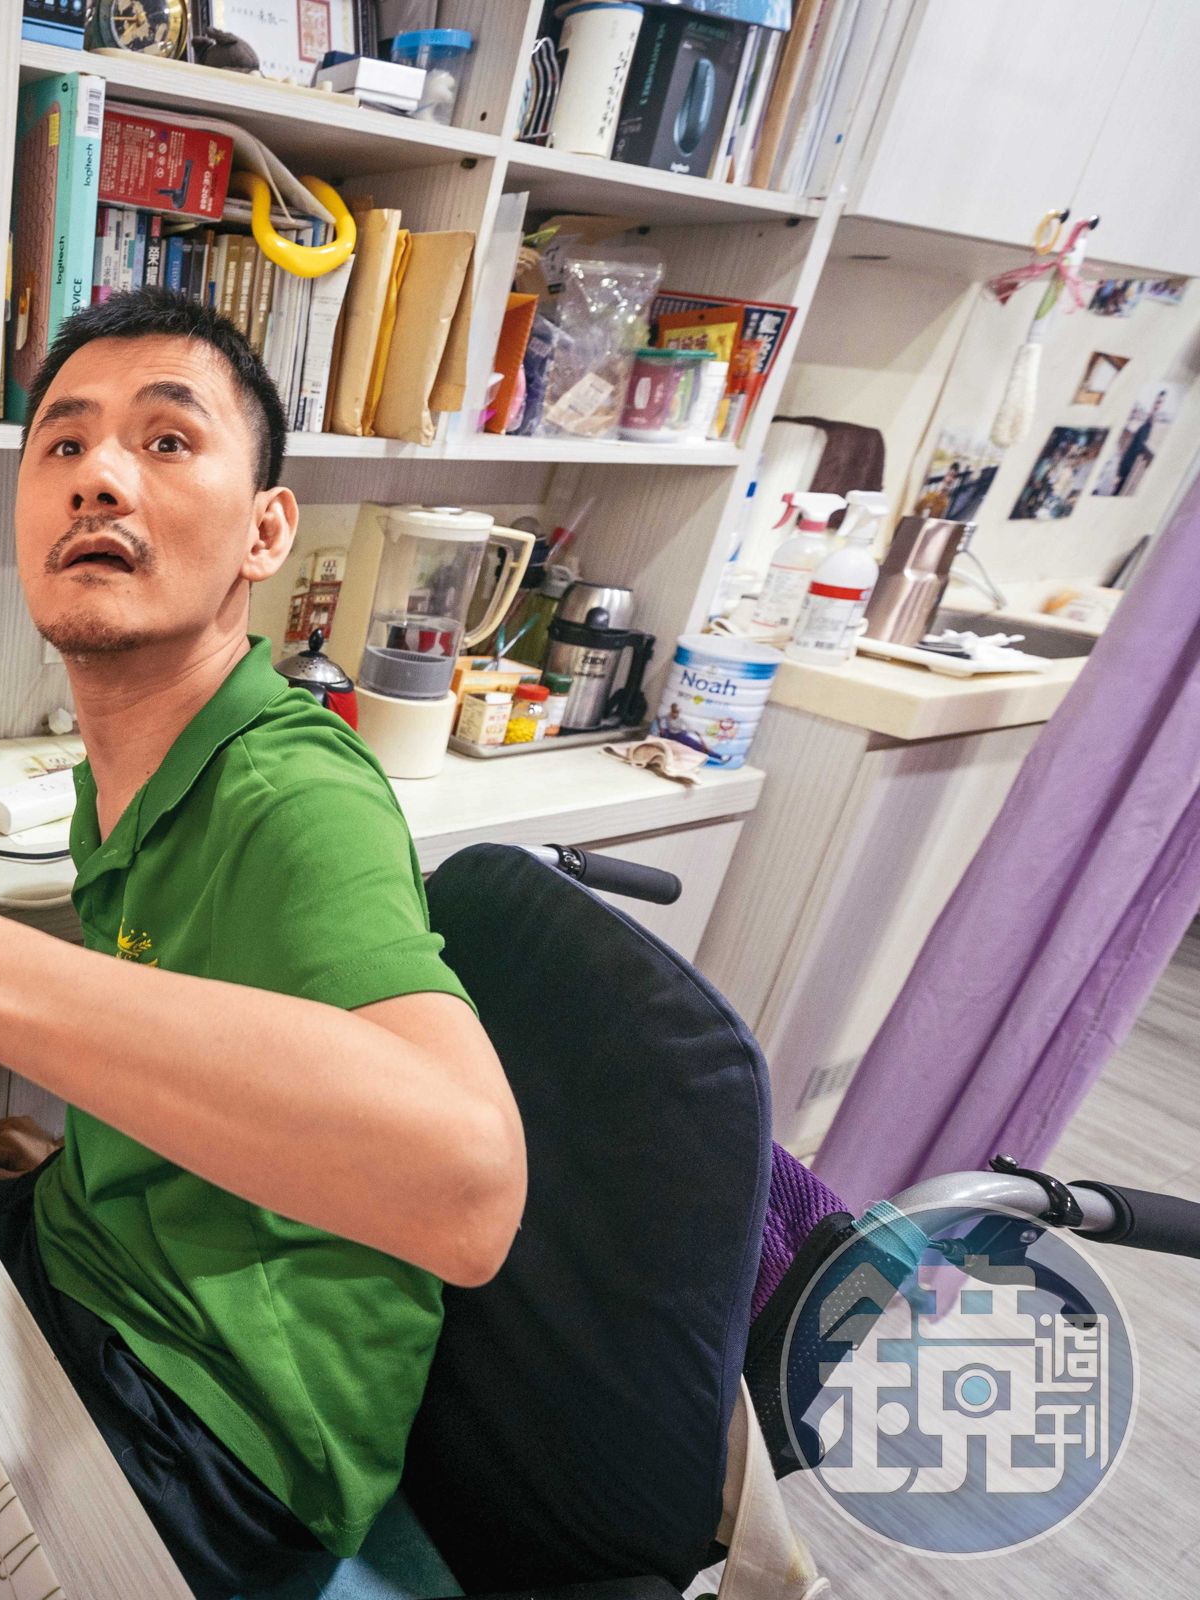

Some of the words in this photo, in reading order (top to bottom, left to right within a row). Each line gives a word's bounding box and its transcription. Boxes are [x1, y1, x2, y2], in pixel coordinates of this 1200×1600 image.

[84, 143, 93, 186] logitech
[56, 235, 65, 285] logitech
[680, 669, 737, 697] Noah
